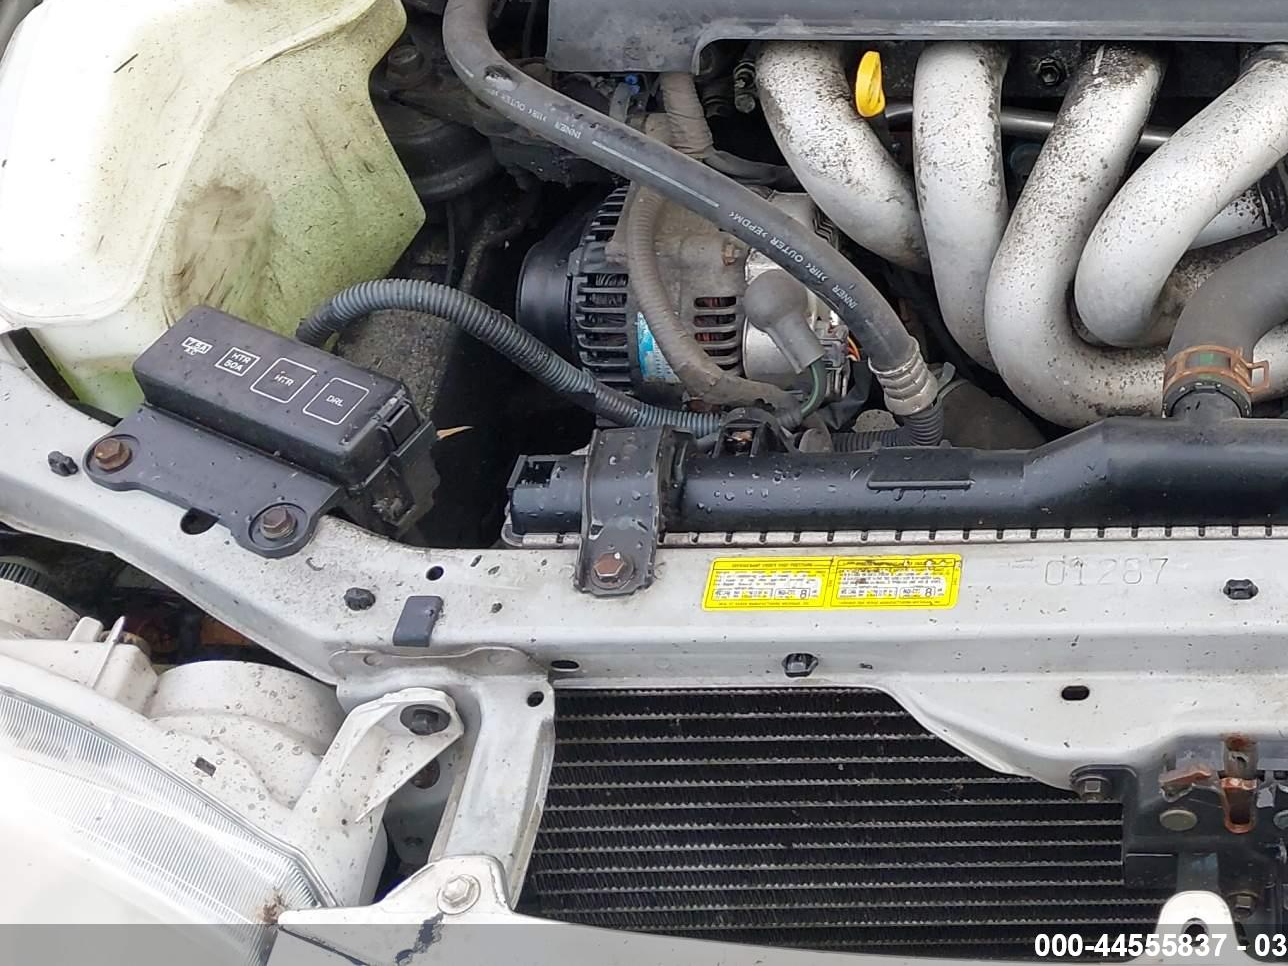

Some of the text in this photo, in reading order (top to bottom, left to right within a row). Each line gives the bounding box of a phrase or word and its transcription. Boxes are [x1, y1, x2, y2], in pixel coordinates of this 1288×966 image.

[770, 236, 804, 264] OUTER
[831, 284, 858, 310] INNER
[231, 352, 252, 364] HTR
[223, 360, 244, 372] 50A
[274, 374, 295, 387] HTR
[325, 394, 344, 407] DRL
[1044, 557, 1169, 586] 01287
[800, 589, 807, 599] 8
[925, 587, 932, 597] 8
